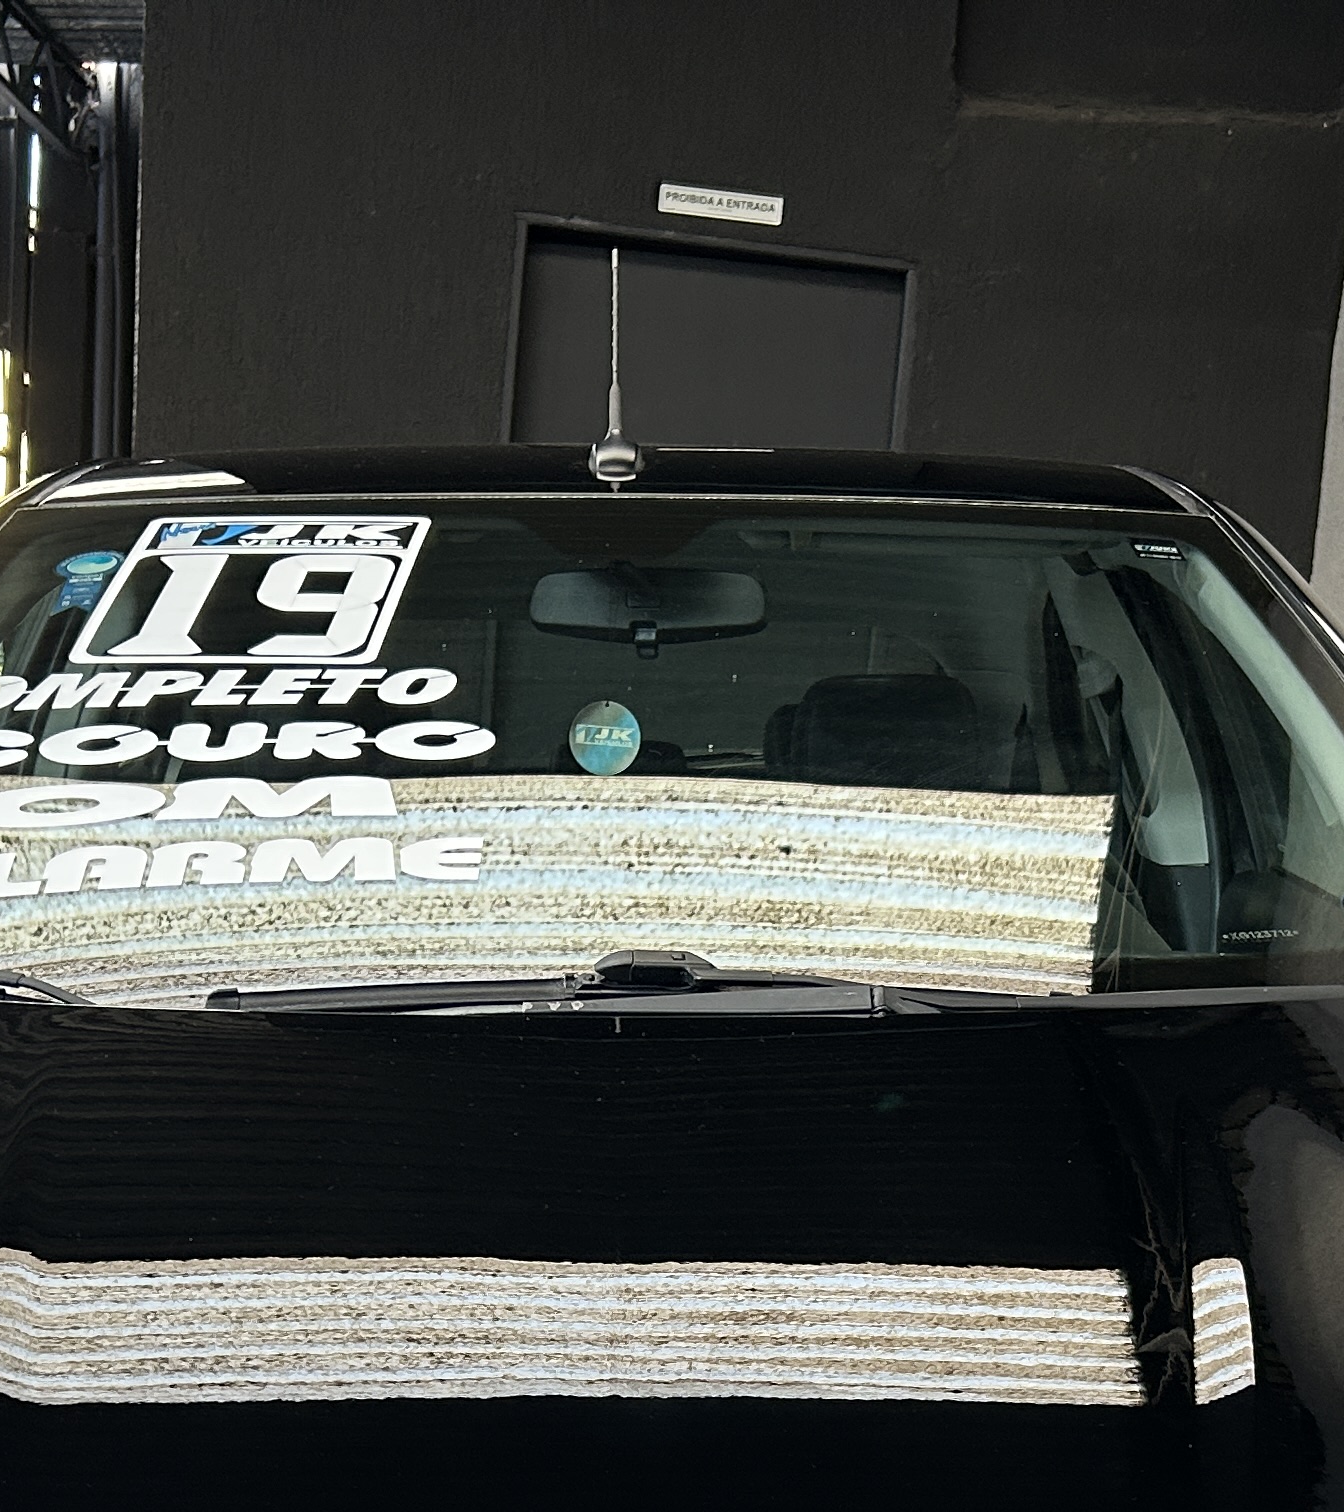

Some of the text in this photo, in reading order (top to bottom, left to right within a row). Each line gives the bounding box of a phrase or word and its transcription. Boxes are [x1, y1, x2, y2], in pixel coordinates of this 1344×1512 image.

[665, 191, 714, 206] PROIBIDA
[716, 197, 724, 207] A
[726, 199, 776, 213] ENTRADA
[107, 553, 397, 657] 19
